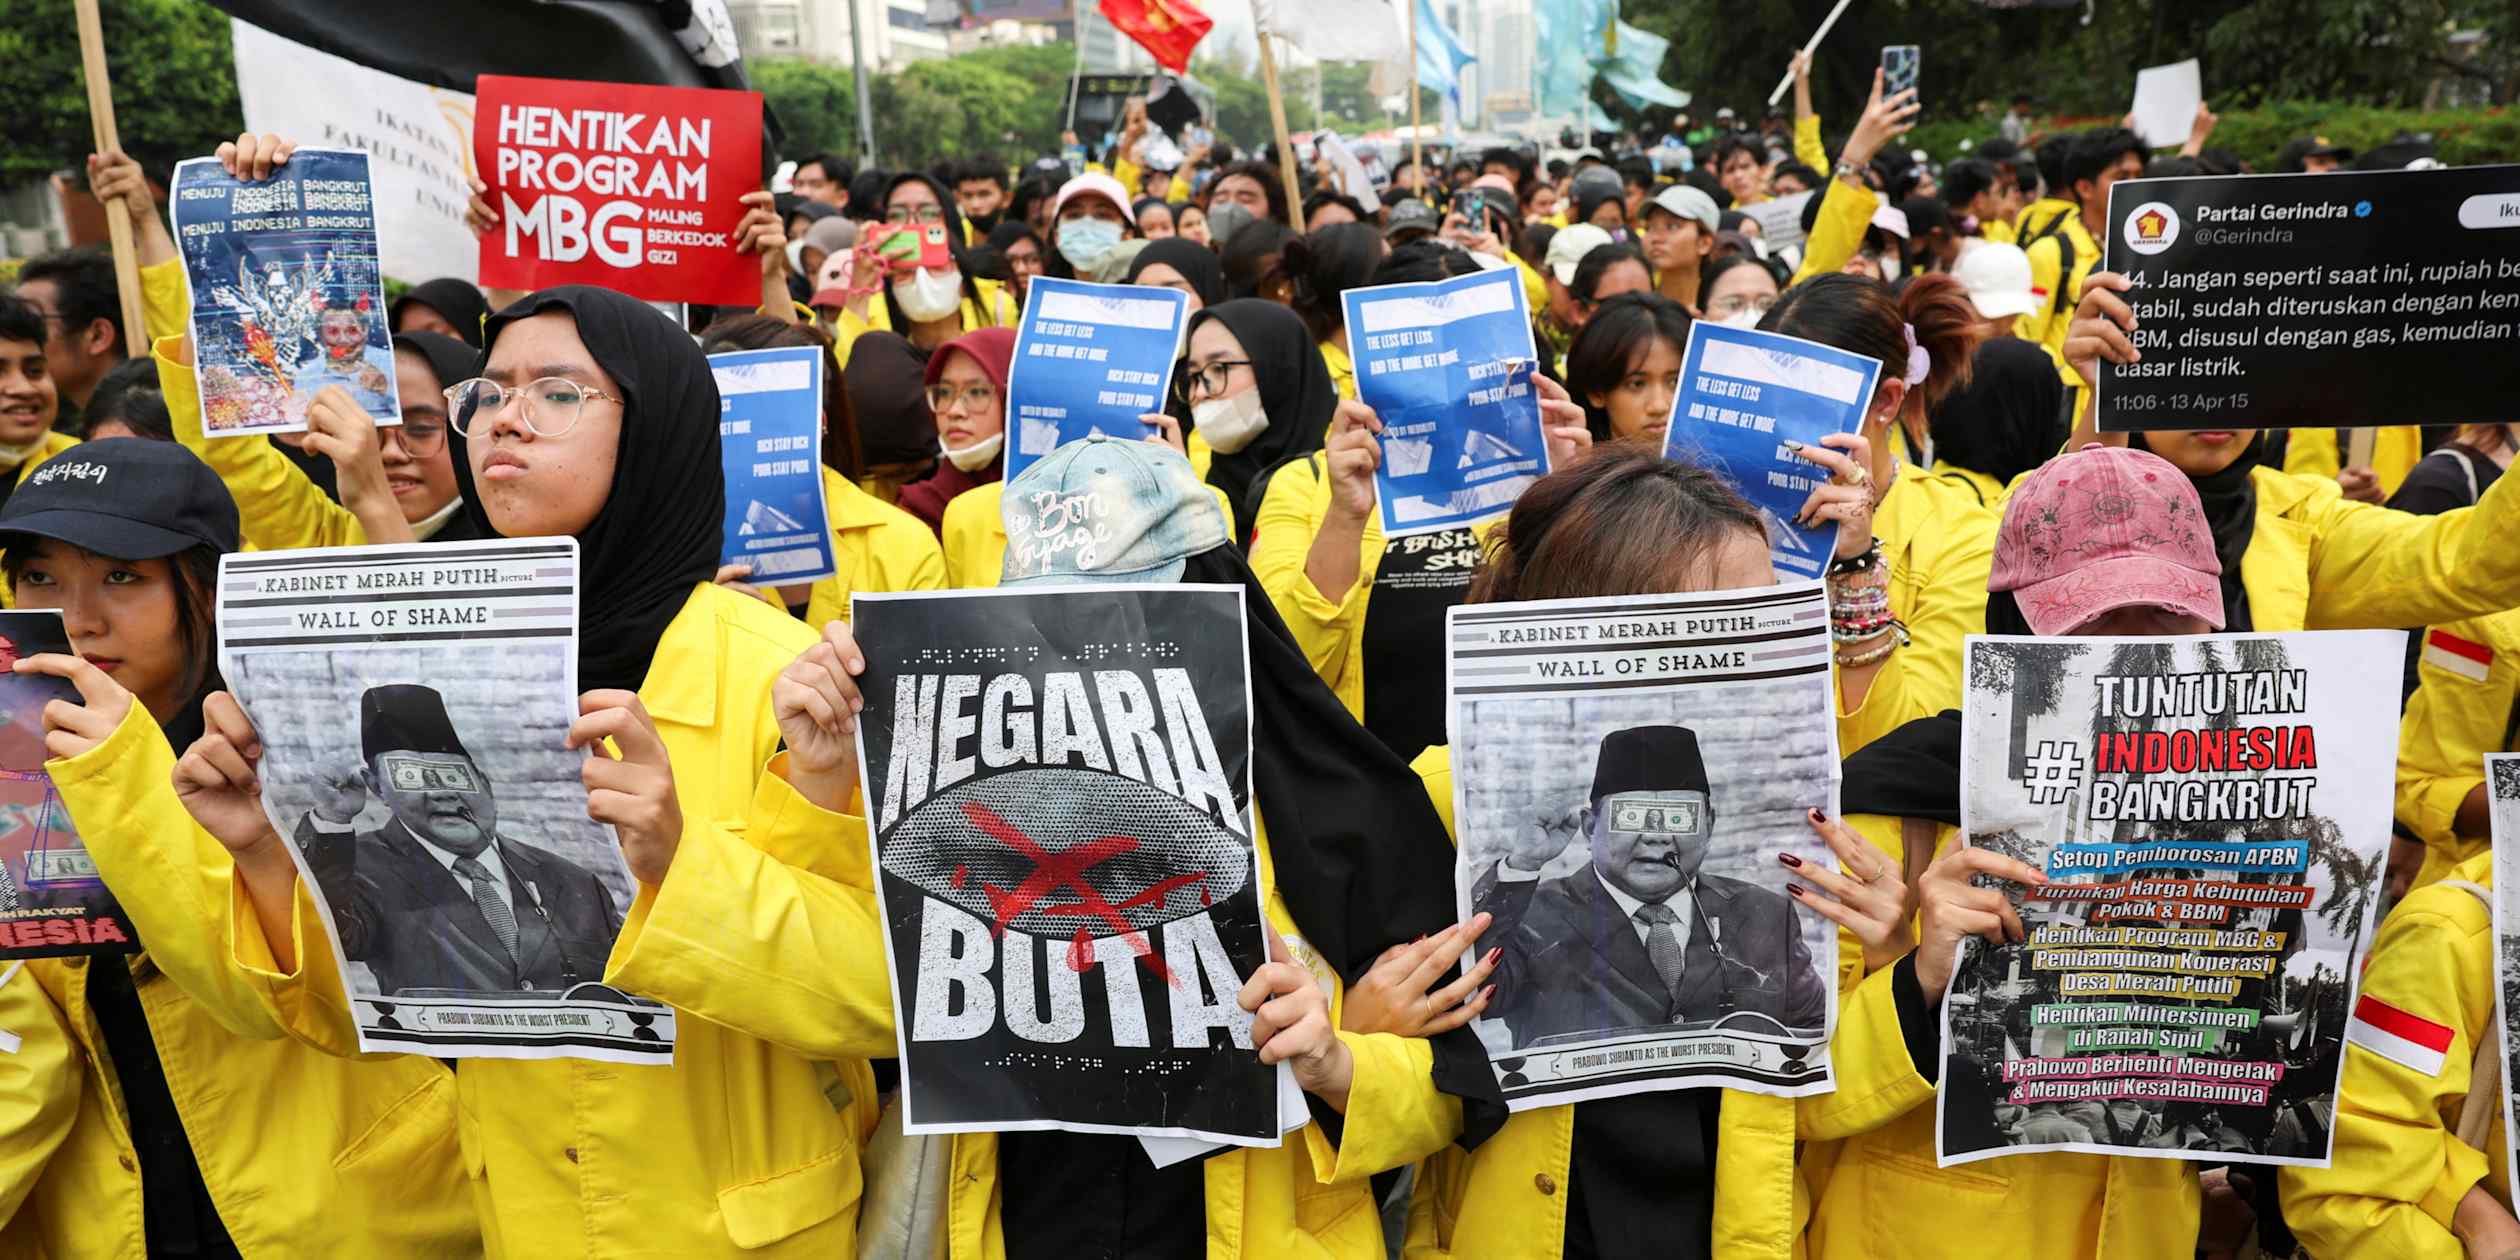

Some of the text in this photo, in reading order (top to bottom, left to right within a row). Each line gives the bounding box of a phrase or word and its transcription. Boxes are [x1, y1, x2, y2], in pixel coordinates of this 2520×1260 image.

[498, 104, 711, 158] HENTIKAN
[498, 147, 707, 202] PROGRAM
[181, 179, 367, 200] MENUJU INDONESIA BANGKRUT
[648, 208, 703, 225] MALING
[2197, 200, 2349, 222] Partai Gerindra
[183, 216, 371, 237] MENUJU INDONESIA BANGKRUT
[502, 191, 644, 268] MBG
[648, 229, 727, 247] BERKEDOK
[2195, 227, 2293, 245] @Gerindra
[647, 250, 677, 265] GIZI
[2159, 270, 2237, 292] Jangan
[2243, 266, 2322, 290] seperti
[2328, 265, 2377, 285] saat
[2384, 262, 2414, 285] ini,
[2421, 259, 2492, 284] rupiah
[2131, 298, 2186, 321] tabil,
[2192, 297, 2261, 318] sudah
[2267, 294, 2386, 317] diteruskan
[2392, 292, 2473, 316] dengan
[2128, 329, 2173, 350] BM,
[2179, 327, 2258, 348] disusul
[2265, 326, 2348, 350] dengan
[2353, 327, 2396, 348] gas,
[2403, 320, 2511, 342] kemudian
[2181, 357, 2246, 377] listrik.
[1696, 376, 1761, 401] THE LESS GET LESS
[2113, 394, 2249, 412] 11:06 13 Apr 15
[265, 575, 348, 593] KABINET
[357, 571, 424, 589] MERAH
[433, 569, 498, 586] PUTIH
[299, 607, 487, 629] WALL OF SHAME
[1500, 626, 1588, 644] KABINET
[1598, 622, 1676, 639] MERAH
[1687, 616, 1755, 633] PUTIH
[1538, 652, 1745, 678] WALL OF SHAME
[2095, 669, 2307, 719] TUNTUTAN
[879, 668, 1248, 839] NEGARA
[2024, 726, 2317, 804] # INDONESIA
[2089, 777, 2317, 821] BANGKRUT
[2053, 848, 2298, 870] Setop Pemborosan APBN
[2130, 880, 2189, 900] Harga
[2193, 883, 2305, 904] Kebutuhan
[18, 907, 86, 918] RAKYAT
[2099, 903, 2225, 921] Pokok & BBM
[2035, 927, 2277, 948] Hentikan Program MBG &
[912, 895, 1258, 1050] BUTA
[2036, 951, 2270, 972] Pembangunan Koperasi
[2064, 974, 2233, 994] Desa Merah Putih
[504, 1014, 514, 1026] AS
[515, 1014, 528, 1026] THE
[529, 1014, 552, 1027] WORST
[554, 1013, 591, 1026] PRESIDENT
[2037, 1006, 2250, 1028] Hentikan Militersimen
[2075, 1030, 2203, 1048] di Ranah Sipil
[1573, 1043, 1735, 1069] PRABOWO SUBIANTO AS THE WORST PRESIDENT
[2008, 1057, 2276, 1081] Prabowo Berhenti Mengelak
[2013, 1079, 2264, 1103] & Mengakui Kesalahannya
